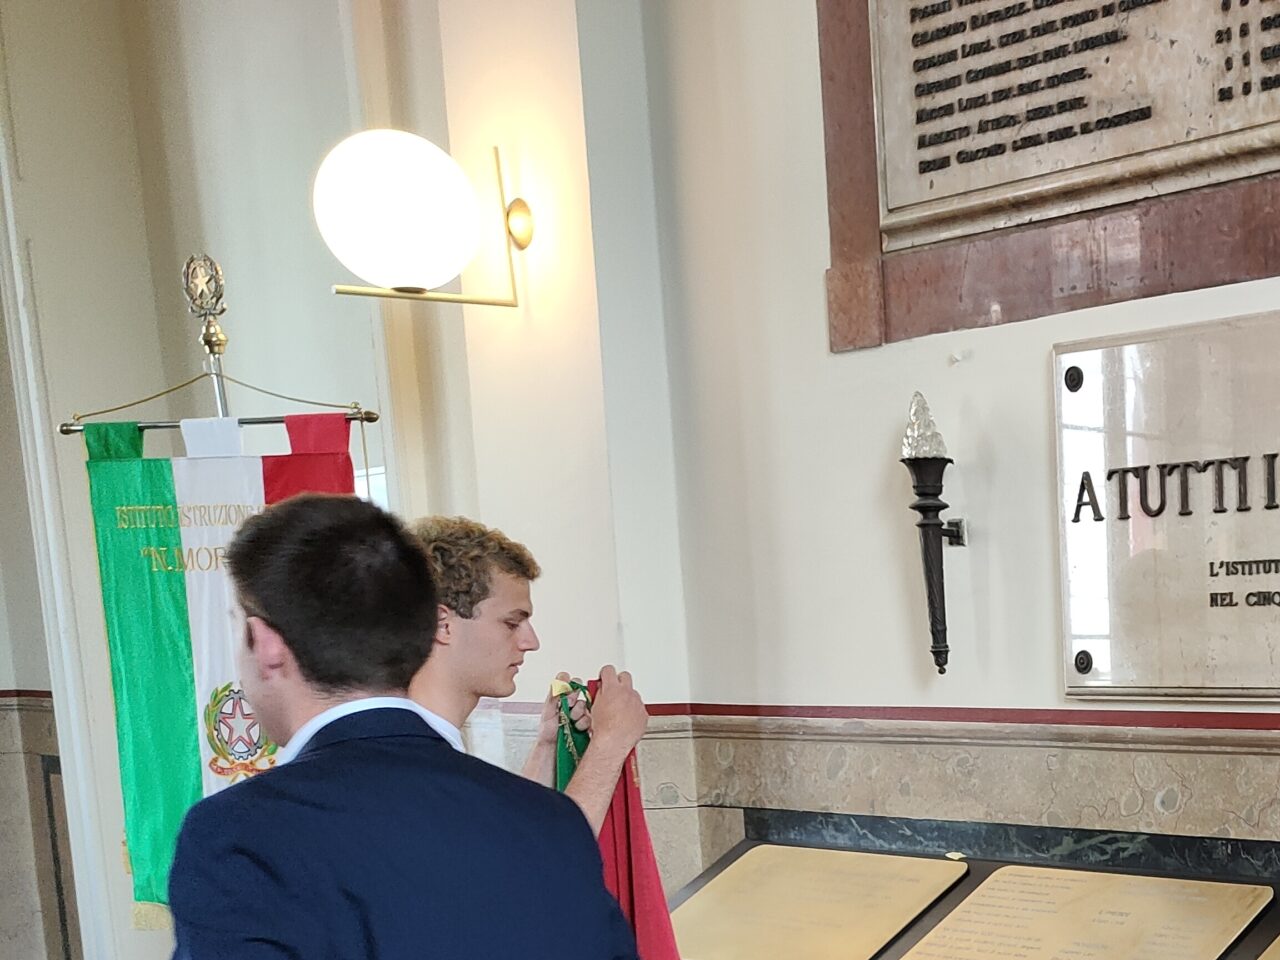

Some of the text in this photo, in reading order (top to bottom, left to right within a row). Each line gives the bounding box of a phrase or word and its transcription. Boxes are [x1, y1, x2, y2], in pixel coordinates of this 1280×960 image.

[1072, 471, 1105, 523] A
[1107, 455, 1251, 521] TUTTI
[1263, 453, 1280, 510] I
[1210, 592, 1239, 608] NEL
